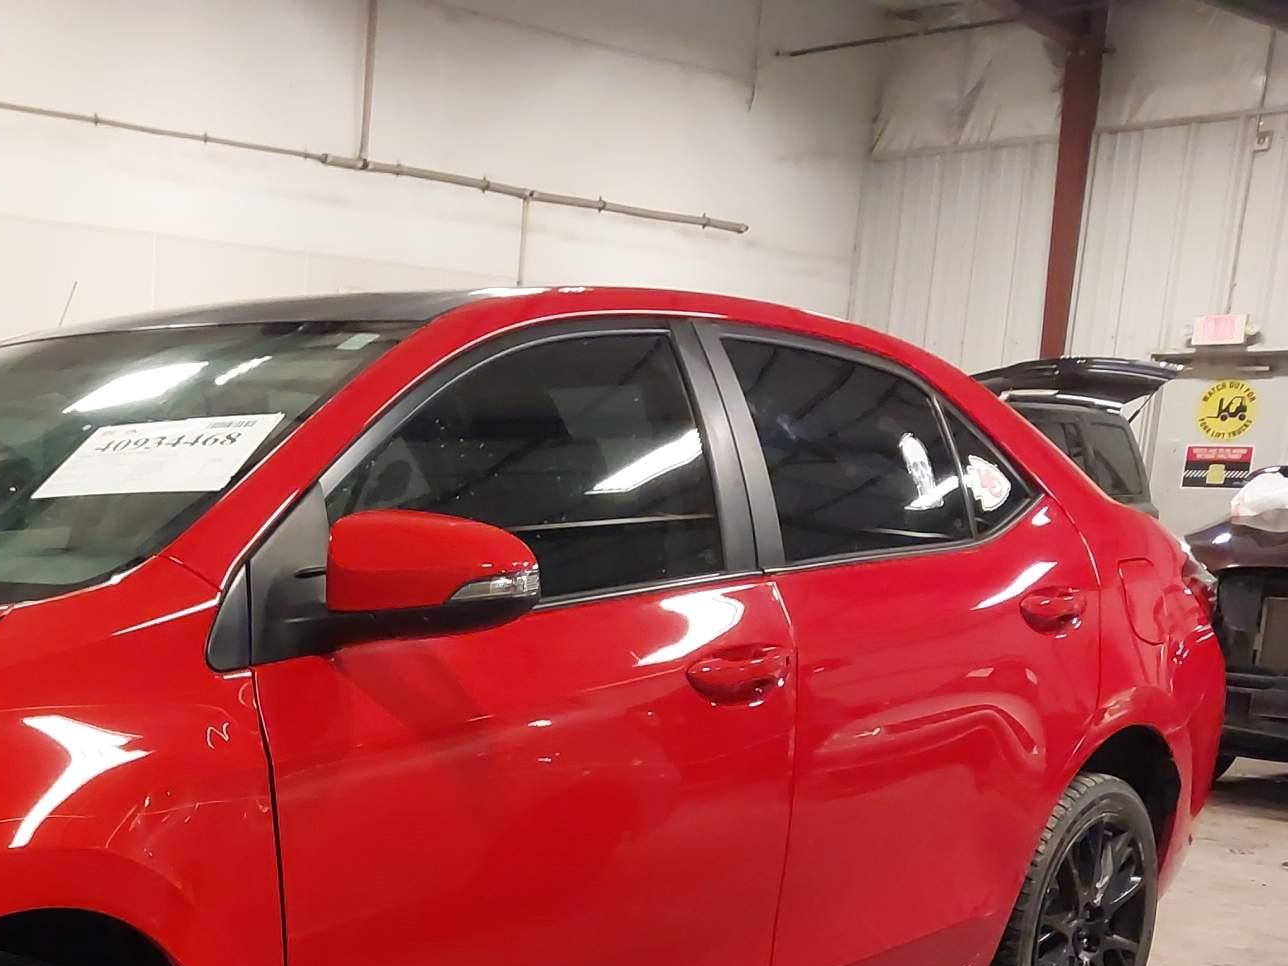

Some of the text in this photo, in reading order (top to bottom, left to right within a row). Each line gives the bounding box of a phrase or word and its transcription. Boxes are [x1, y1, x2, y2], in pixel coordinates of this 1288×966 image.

[1202, 381, 1257, 402] WATCH OUT FOR
[95, 430, 243, 454] 40934468
